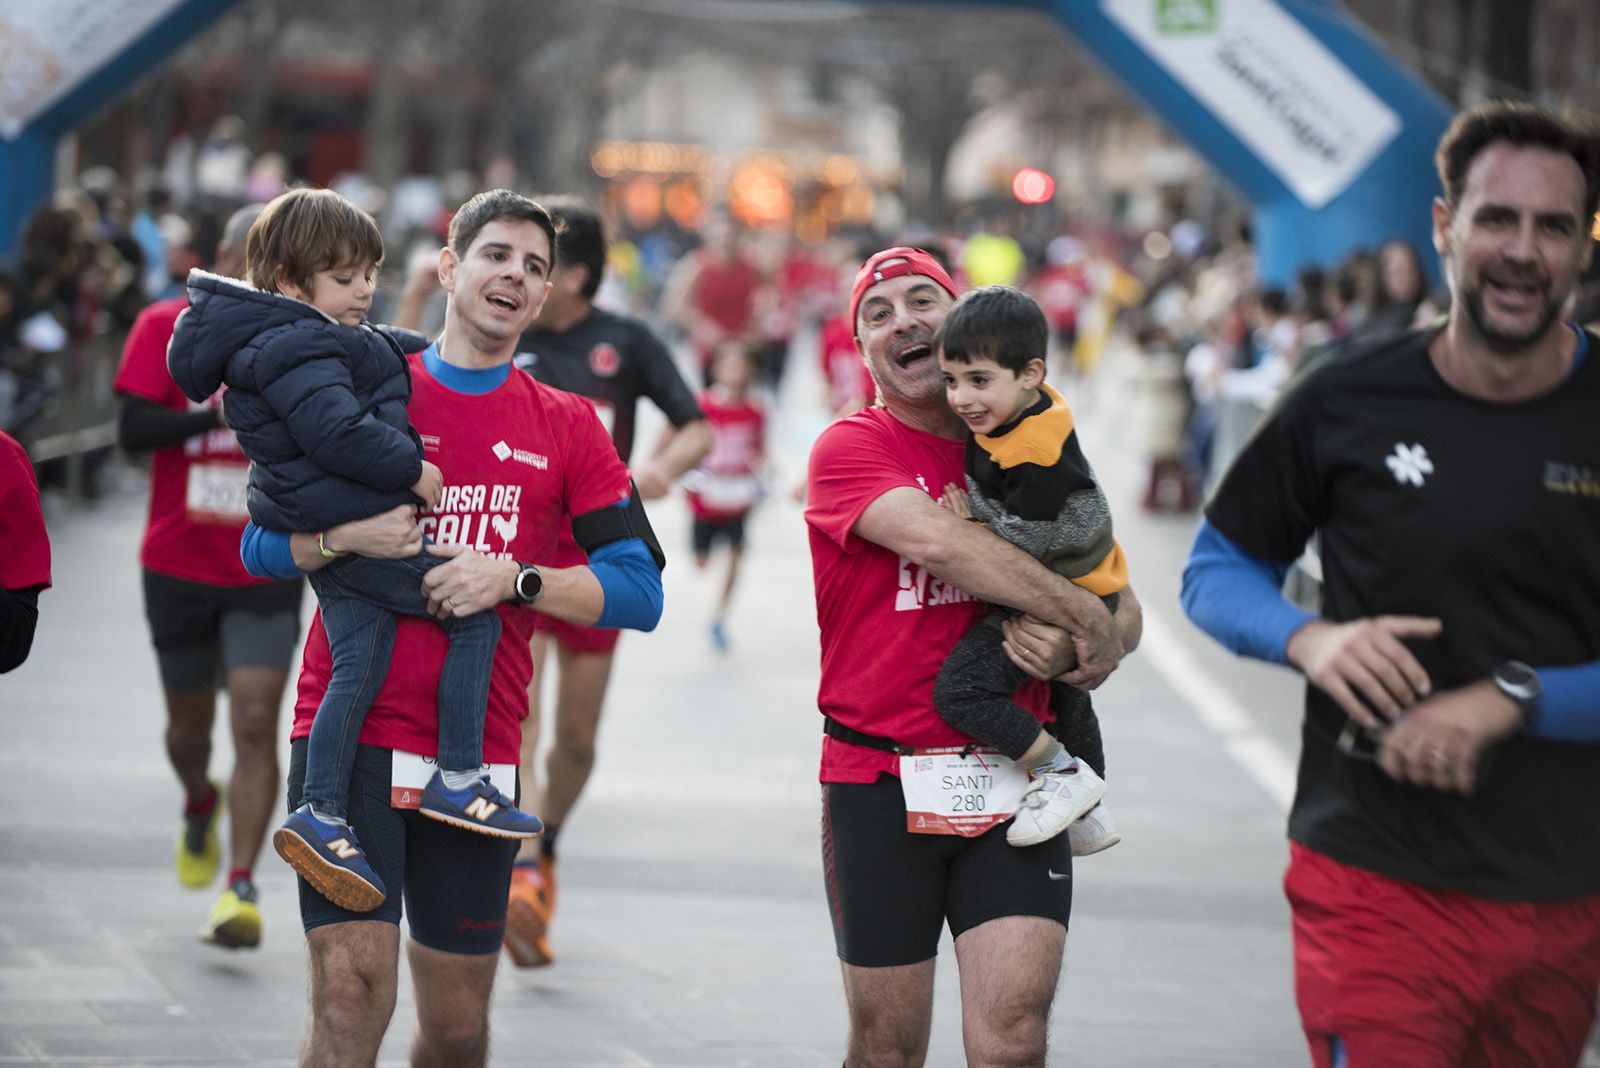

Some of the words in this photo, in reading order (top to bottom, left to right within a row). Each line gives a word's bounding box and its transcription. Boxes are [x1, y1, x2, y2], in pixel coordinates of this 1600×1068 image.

[431, 484, 486, 514] URSA
[489, 484, 521, 513] DEL
[941, 774, 993, 791] SANTI
[951, 793, 986, 813] 280
